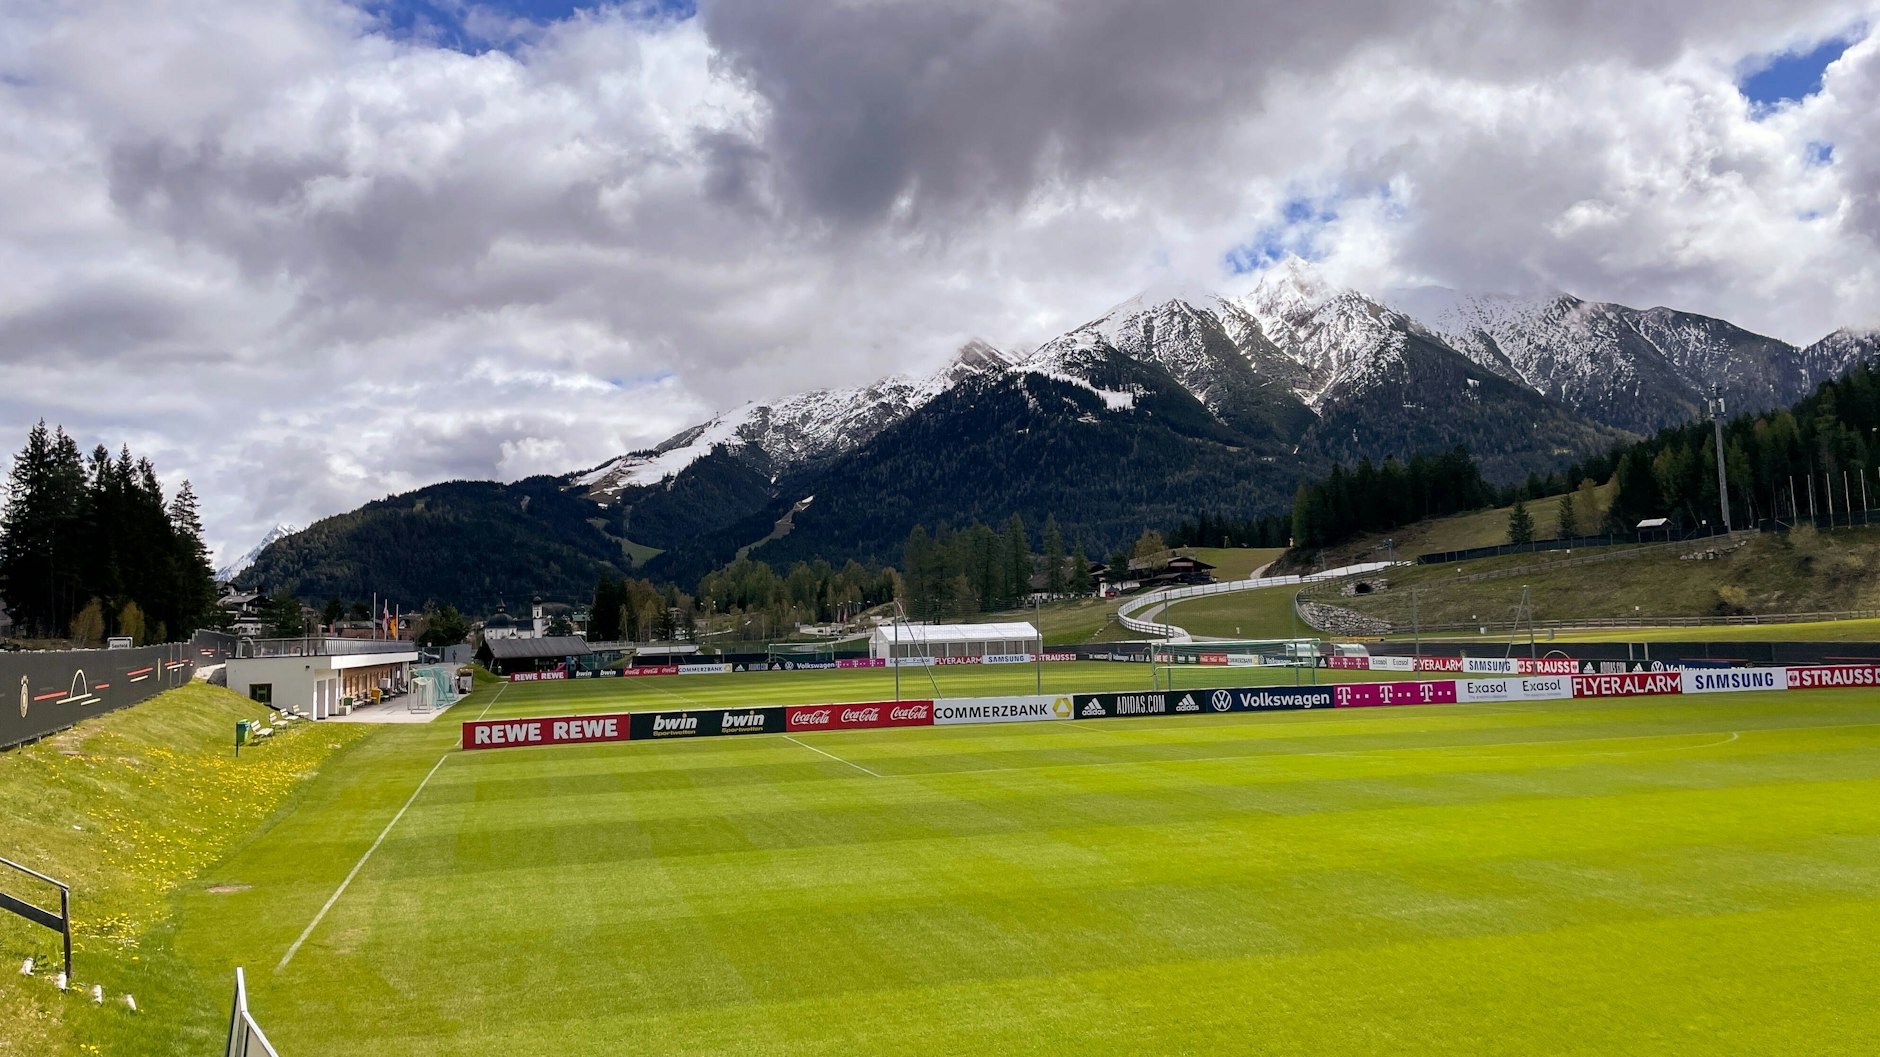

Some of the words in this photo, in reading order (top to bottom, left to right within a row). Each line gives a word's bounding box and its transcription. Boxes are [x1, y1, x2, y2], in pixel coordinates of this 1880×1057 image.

[796, 661, 835, 669] Volkswagen
[935, 656, 983, 665] FLYERALARM
[1469, 660, 1511, 671] SAMSUNG
[514, 672, 538, 681] REWE
[541, 671, 564, 680] REWE
[1695, 672, 1774, 690] SAMSUNG
[1802, 669, 1873, 686] STRAUSS
[1467, 681, 1507, 693] Exasol
[1522, 679, 1561, 692] Exasol
[1573, 675, 1681, 695] FLYERALARM
[1082, 708, 1106, 716] adidas
[1116, 694, 1165, 715] ADIDAS.COM
[1175, 704, 1200, 712] adidas
[1240, 692, 1330, 709] Volkswagen
[791, 709, 832, 726] Coca-Cola
[840, 707, 881, 723] Coca-Cola
[890, 705, 930, 721] Coca-Cola
[934, 703, 1048, 719] COMMERZBANK
[653, 713, 698, 731] bwin
[722, 710, 765, 728] bwin
[475, 722, 542, 744] REWE
[553, 719, 618, 740] REWE
[721, 726, 764, 734] Sportwetten
